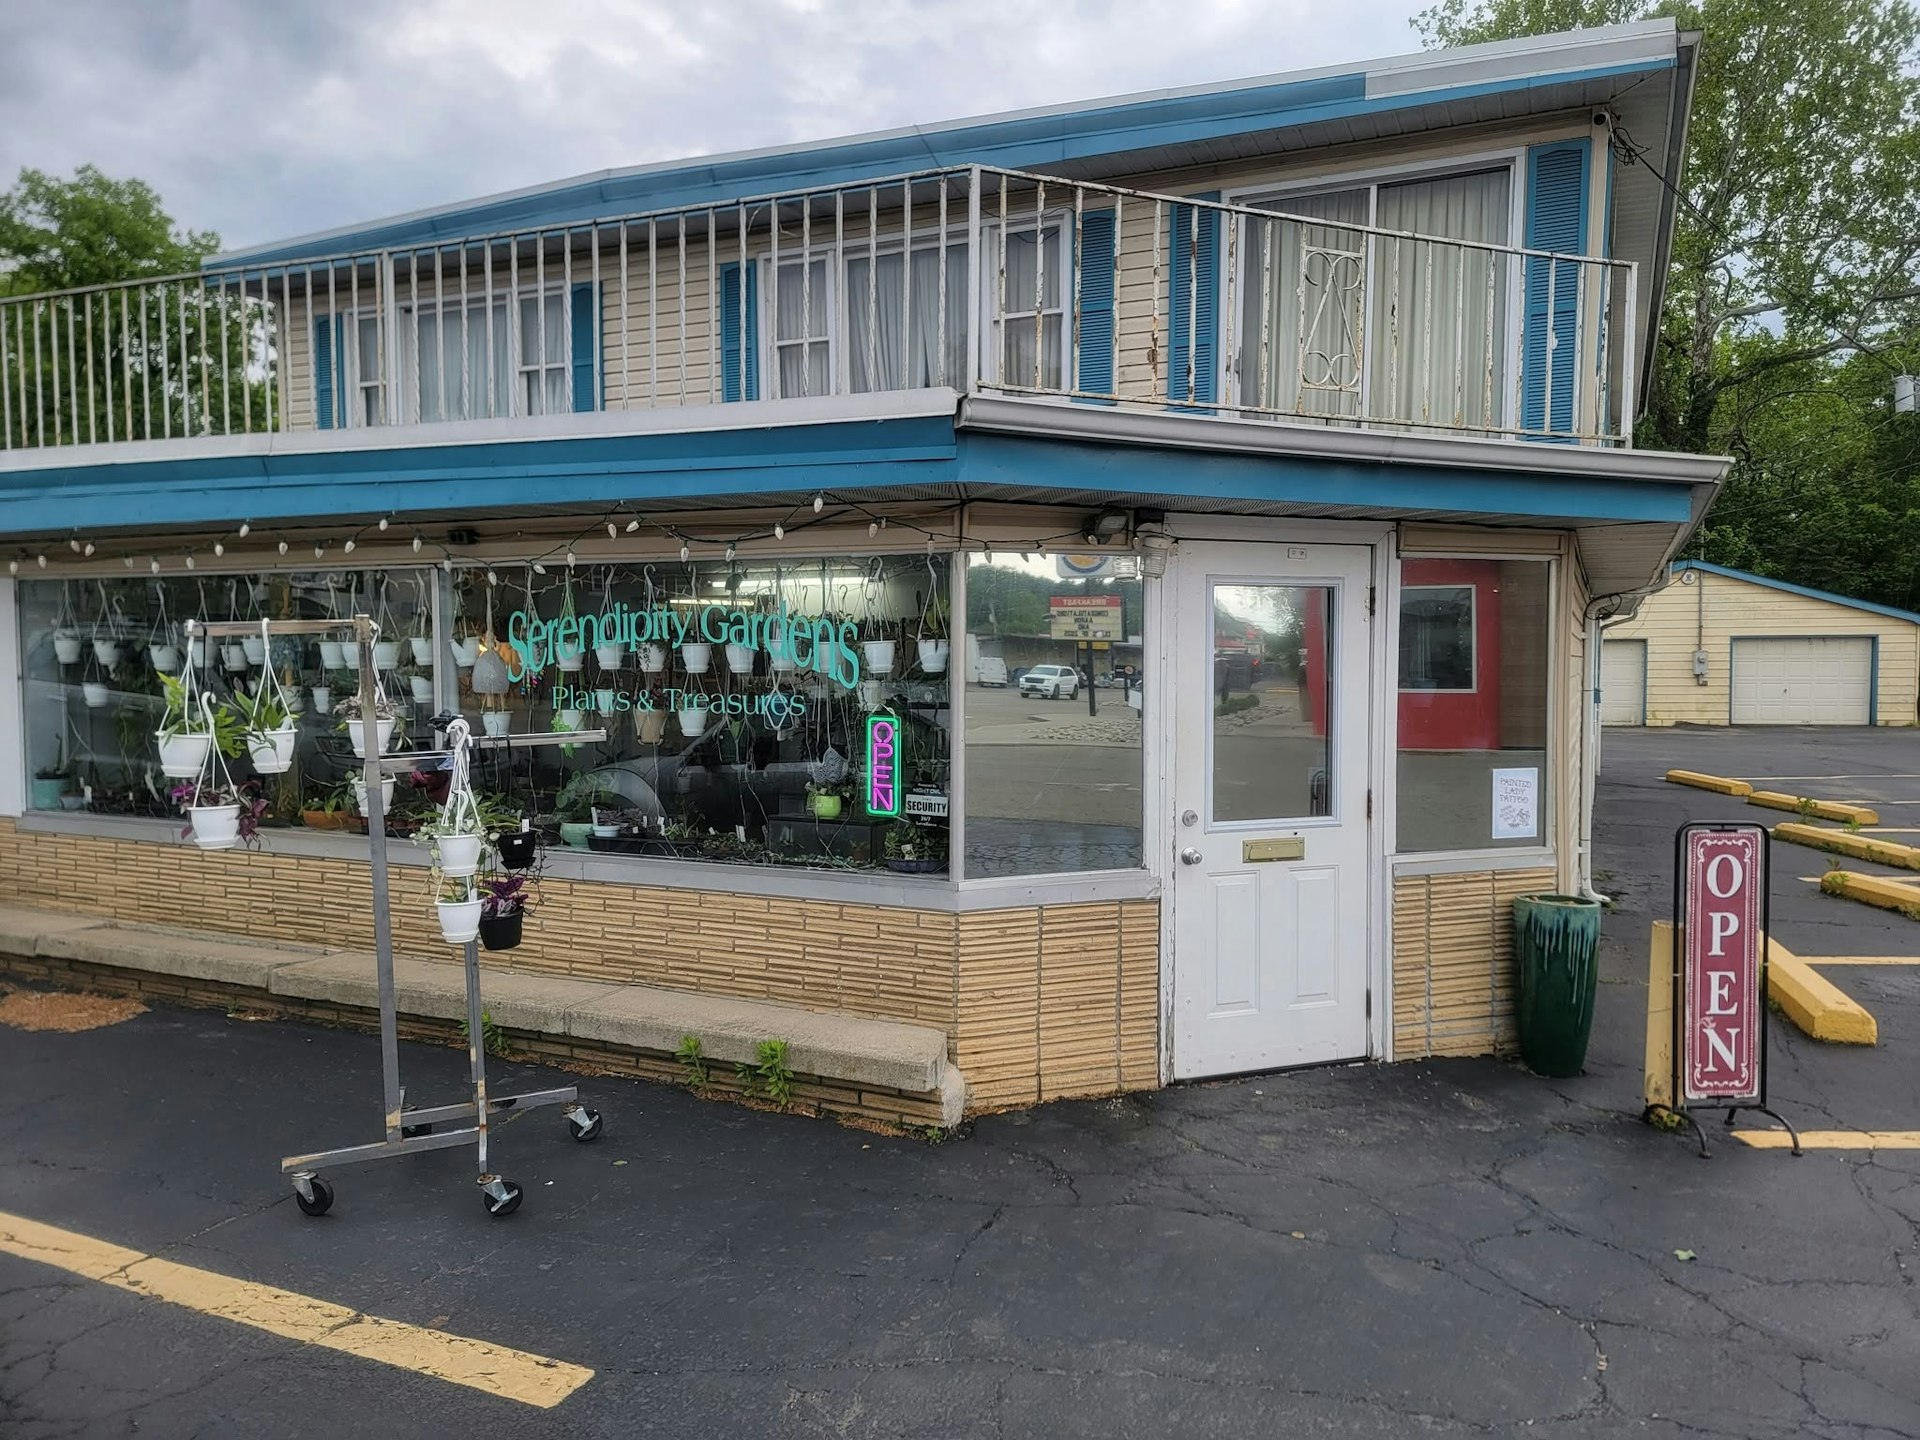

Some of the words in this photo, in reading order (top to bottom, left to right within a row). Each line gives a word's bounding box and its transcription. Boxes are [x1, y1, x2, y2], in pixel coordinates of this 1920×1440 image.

[507, 601, 692, 683] Serendipity
[701, 600, 860, 689] Gardens
[552, 684, 630, 712] Plants
[637, 689, 655, 712] &
[663, 688, 806, 716] Treasures
[872, 721, 894, 812] OPEN
[1500, 777, 1532, 788] PAINTED
[1505, 786, 1526, 795] LADY
[907, 800, 947, 813] SECURITY
[1499, 793, 1529, 804] TATTOO
[1703, 854, 1744, 1073] OPEN
